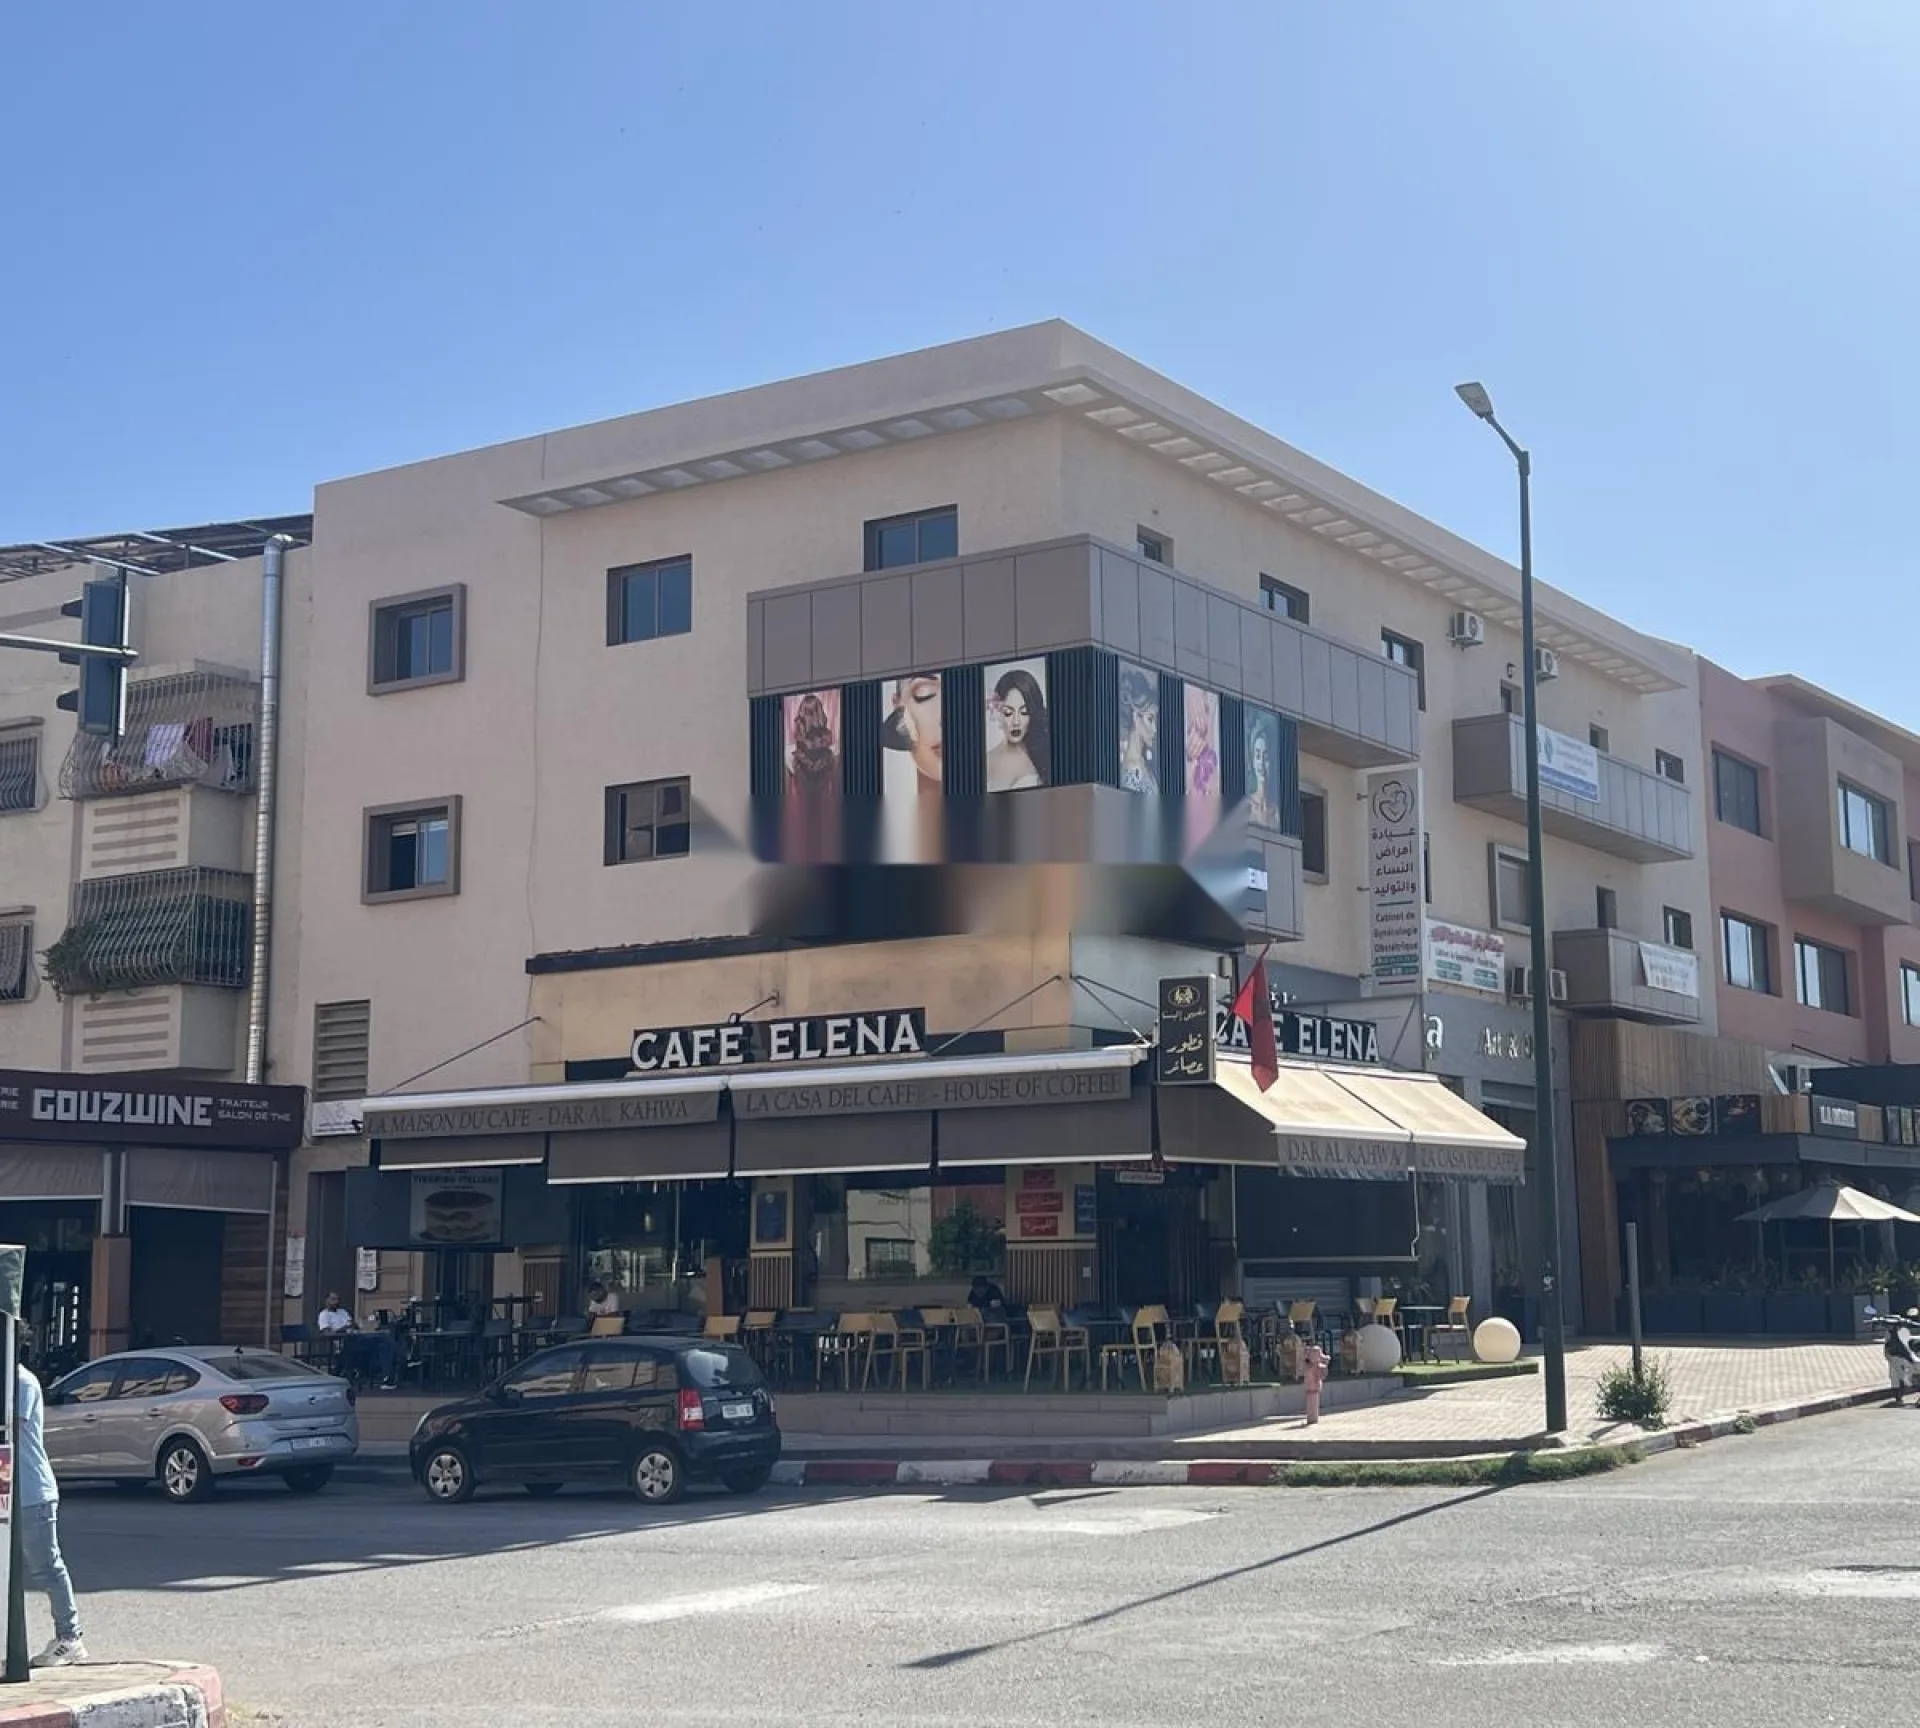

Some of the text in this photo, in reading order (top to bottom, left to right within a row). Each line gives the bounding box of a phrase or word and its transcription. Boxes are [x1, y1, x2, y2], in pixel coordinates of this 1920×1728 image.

[1376, 842, 1412, 860] أمراض
[1376, 861, 1413, 877] النساء
[769, 1013, 921, 1062] ELENA
[1215, 1004, 1380, 1062] CAE ELENA
[218, 1099, 269, 1109] TRAITEUR
[747, 1093, 768, 1112] LA
[774, 1089, 822, 1112] CASA
[829, 1087, 864, 1108] DEL
[945, 1077, 1011, 1102] HOUSE
[1016, 1075, 1042, 1099] OF
[1047, 1073, 1122, 1097] COFFEE
[32, 1088, 213, 1127] GOUZWINE
[218, 1109, 252, 1120] SALON
[255, 1111, 268, 1121] DE
[392, 1112, 454, 1133] MAISON
[460, 1111, 485, 1130] DU
[548, 1105, 583, 1126] DAR
[620, 1099, 688, 1121] KAHWA
[1288, 1139, 1322, 1163] DAR
[1324, 1141, 1344, 1163] AL
